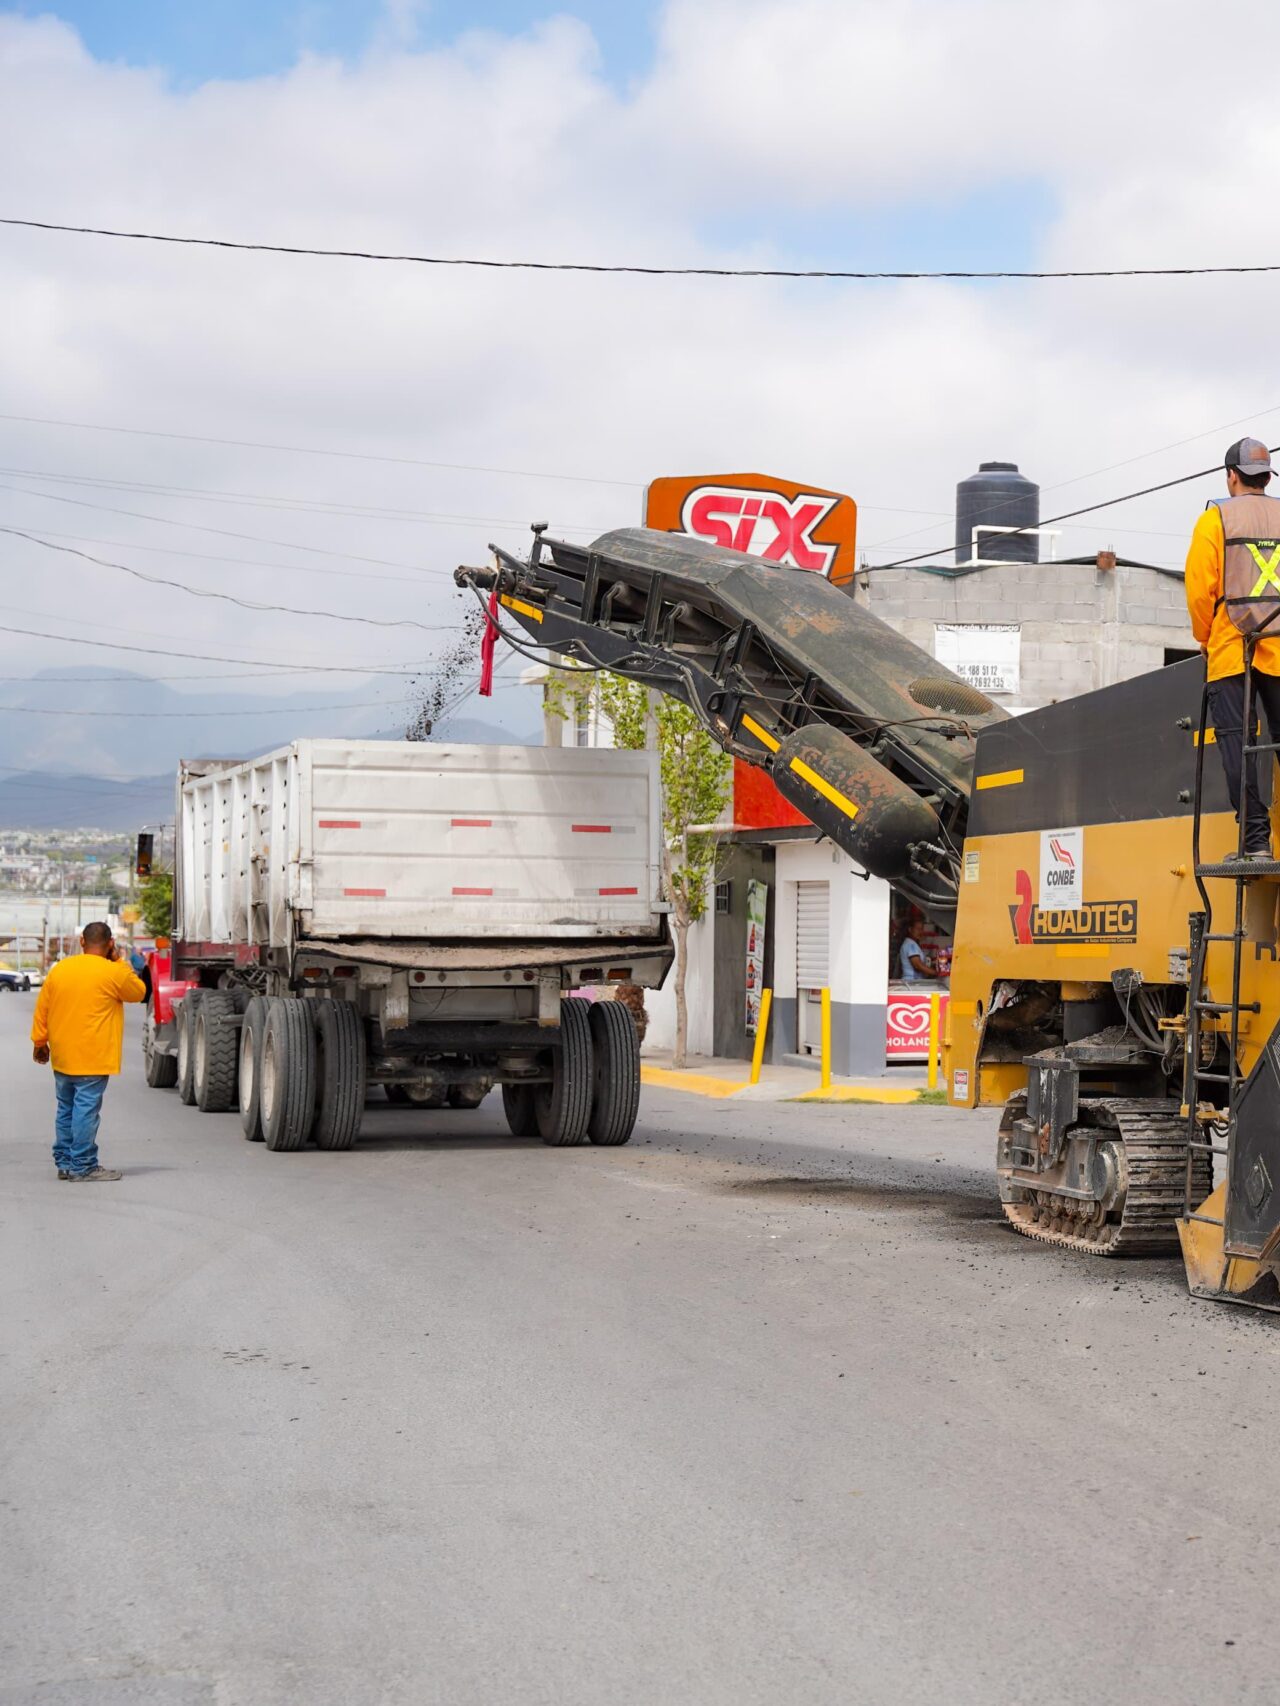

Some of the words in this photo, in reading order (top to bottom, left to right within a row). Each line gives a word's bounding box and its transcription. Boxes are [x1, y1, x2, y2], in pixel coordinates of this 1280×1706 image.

[1047, 870, 1075, 886] CONBE
[1033, 903, 1134, 934] ROADTEC
[886, 1037, 941, 1047] HOLAND
